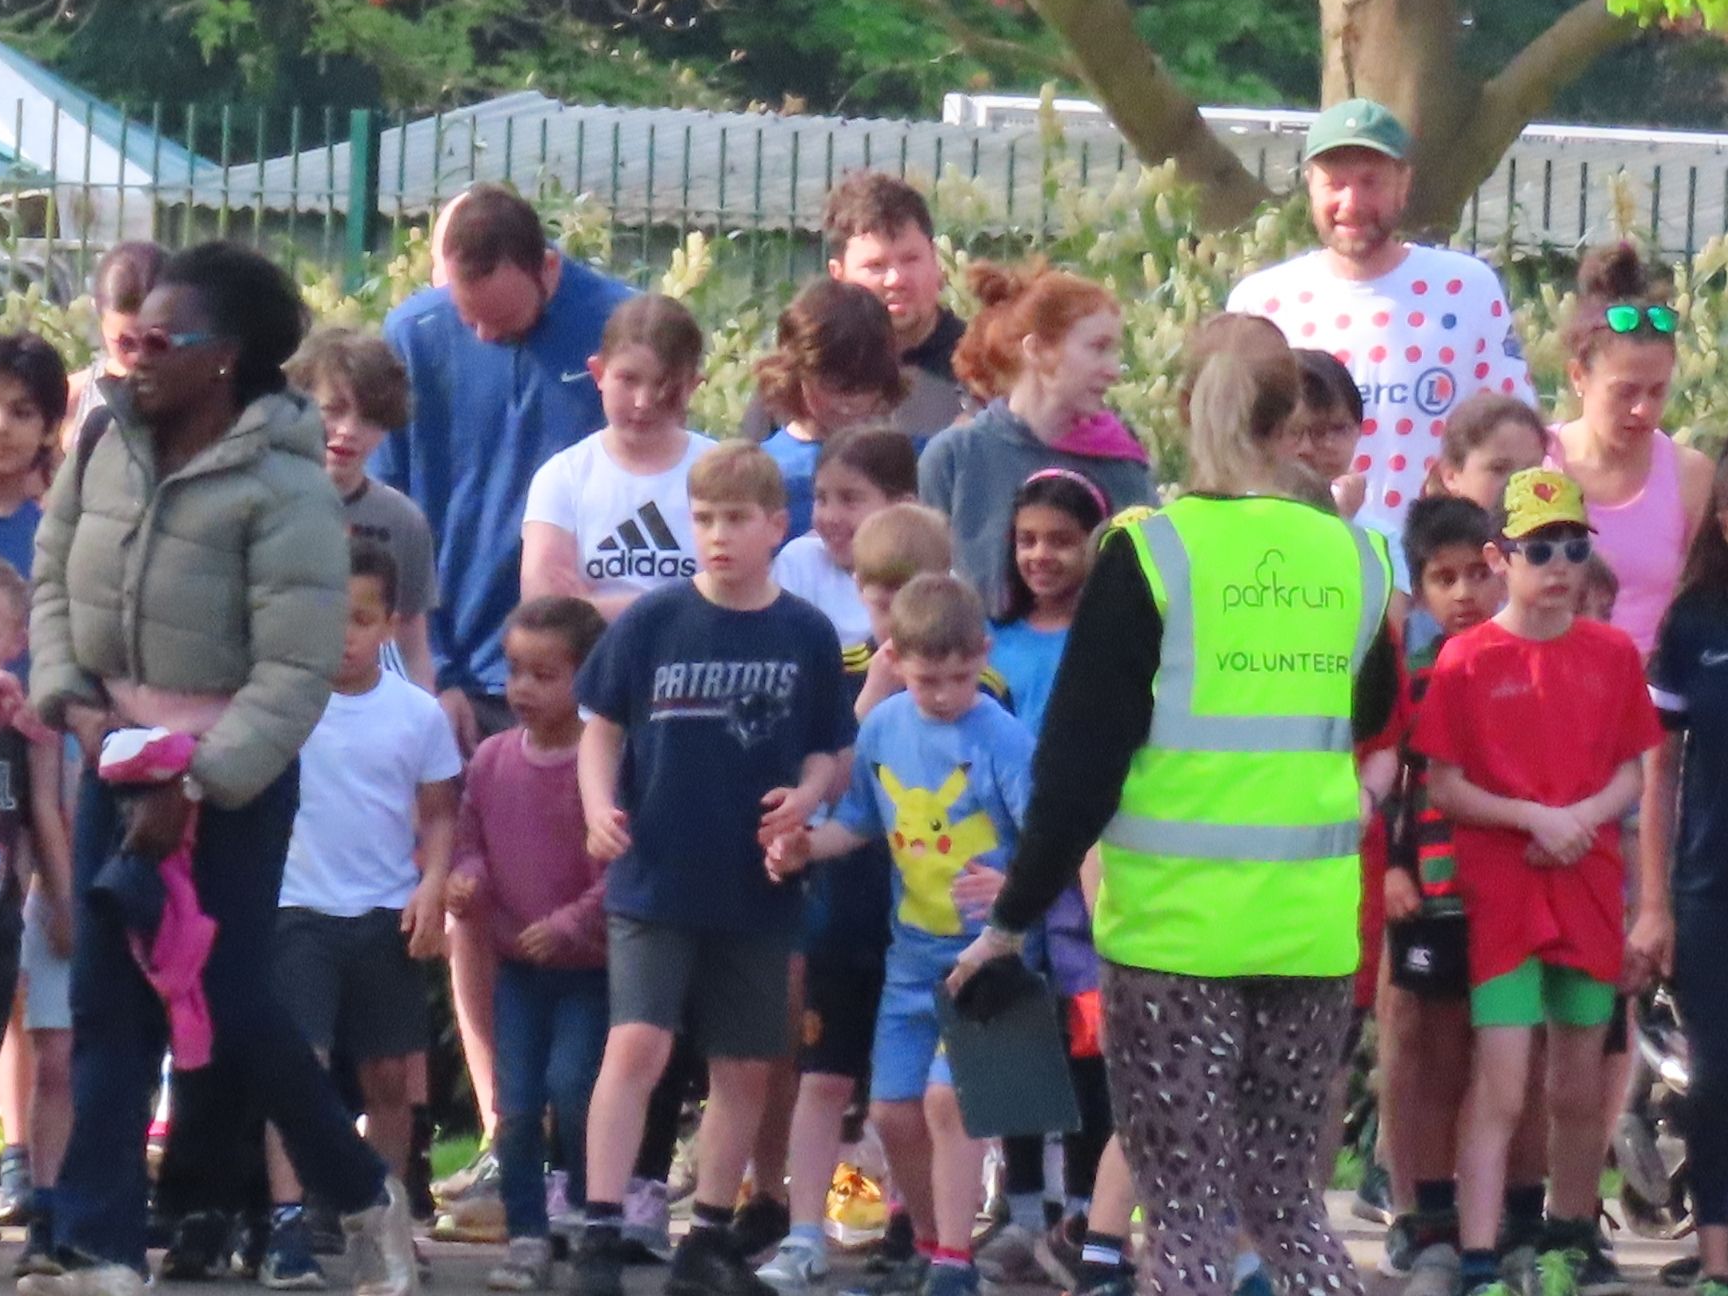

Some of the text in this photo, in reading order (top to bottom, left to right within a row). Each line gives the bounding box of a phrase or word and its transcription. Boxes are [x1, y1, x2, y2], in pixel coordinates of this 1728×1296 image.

[586, 550, 697, 579] adidas
[1222, 568, 1344, 614] parkrun
[1215, 650, 1350, 674] VOLUNTEER
[653, 661, 800, 702] PATRIOTS
